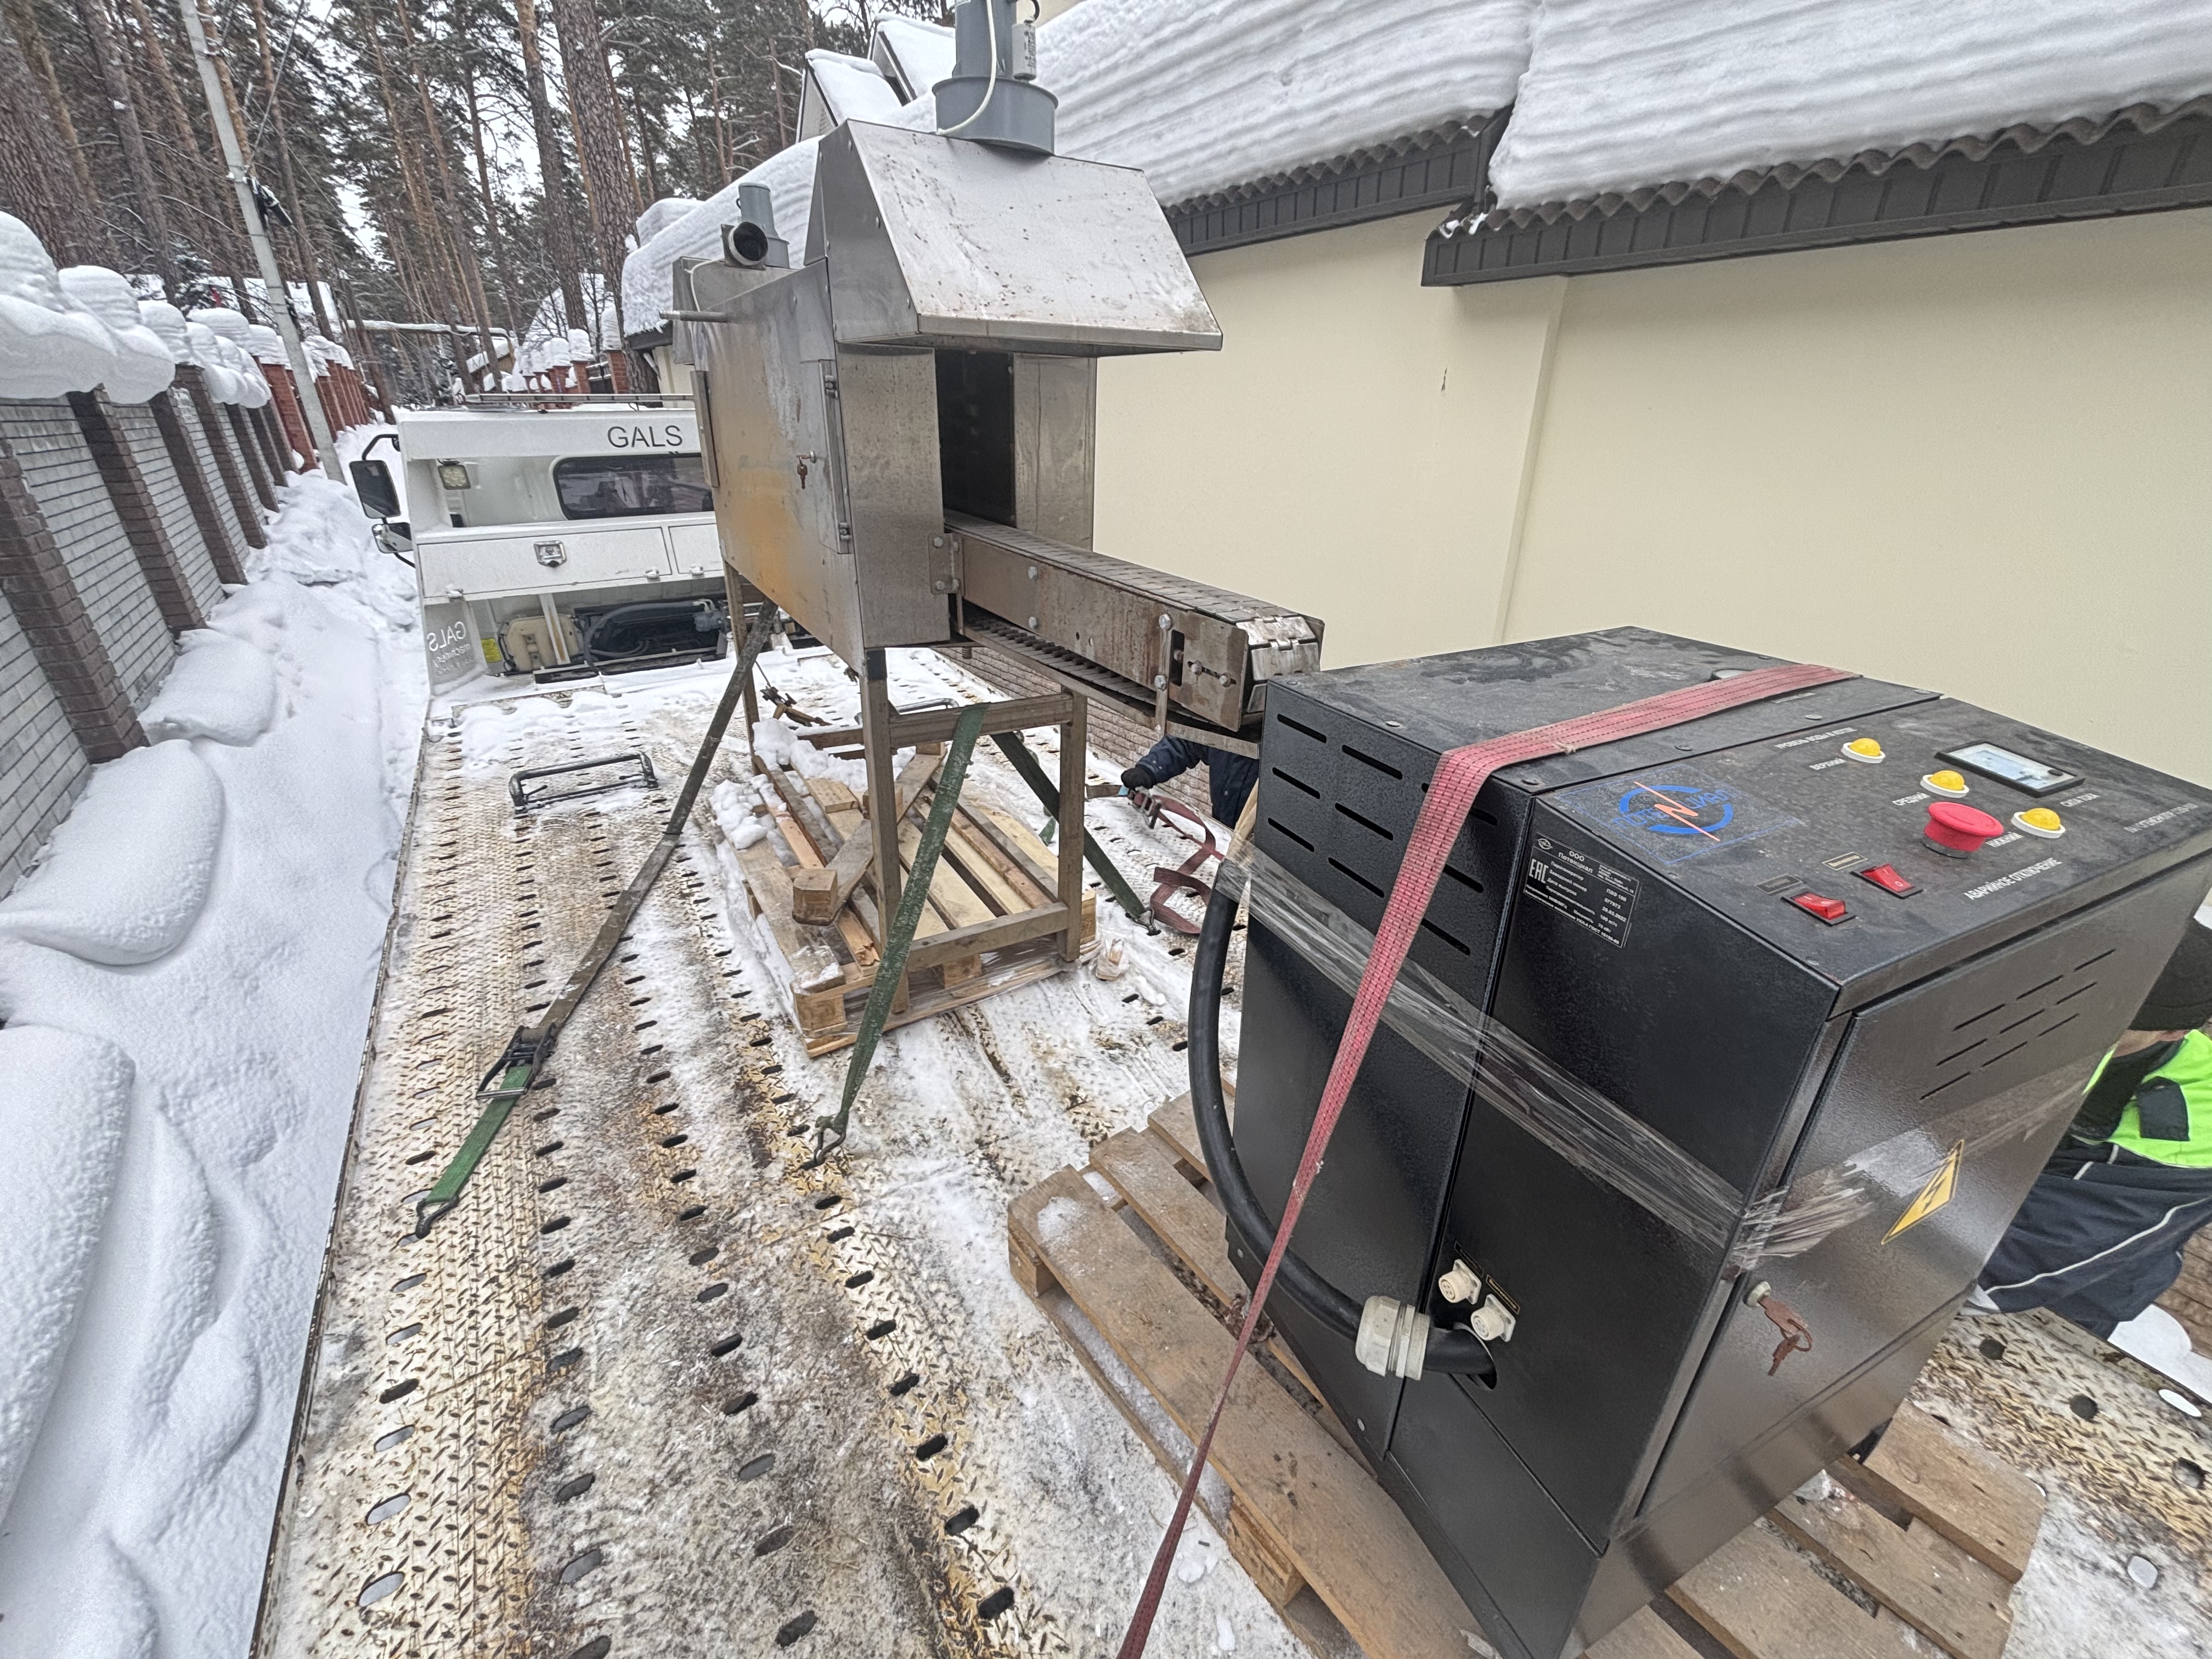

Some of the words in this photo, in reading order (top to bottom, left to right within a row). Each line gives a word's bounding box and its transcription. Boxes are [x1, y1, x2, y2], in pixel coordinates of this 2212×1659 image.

[607, 425, 682, 448] GALS
[1774, 739, 1810, 749] УРОВЕНЬ
[1809, 758, 1847, 770] ВЕРХНИЙ
[1893, 792, 1931, 806] СРЕДНИЙ
[1985, 831, 2024, 848] НИЖНИЙ
[1558, 851, 1593, 874] Потенциал
[1568, 850, 1585, 862] ООО
[1963, 876, 2016, 900] АВАРИЙНОЕ
[2008, 857, 2063, 881] ОТКЛЮЧЕНИЕ
